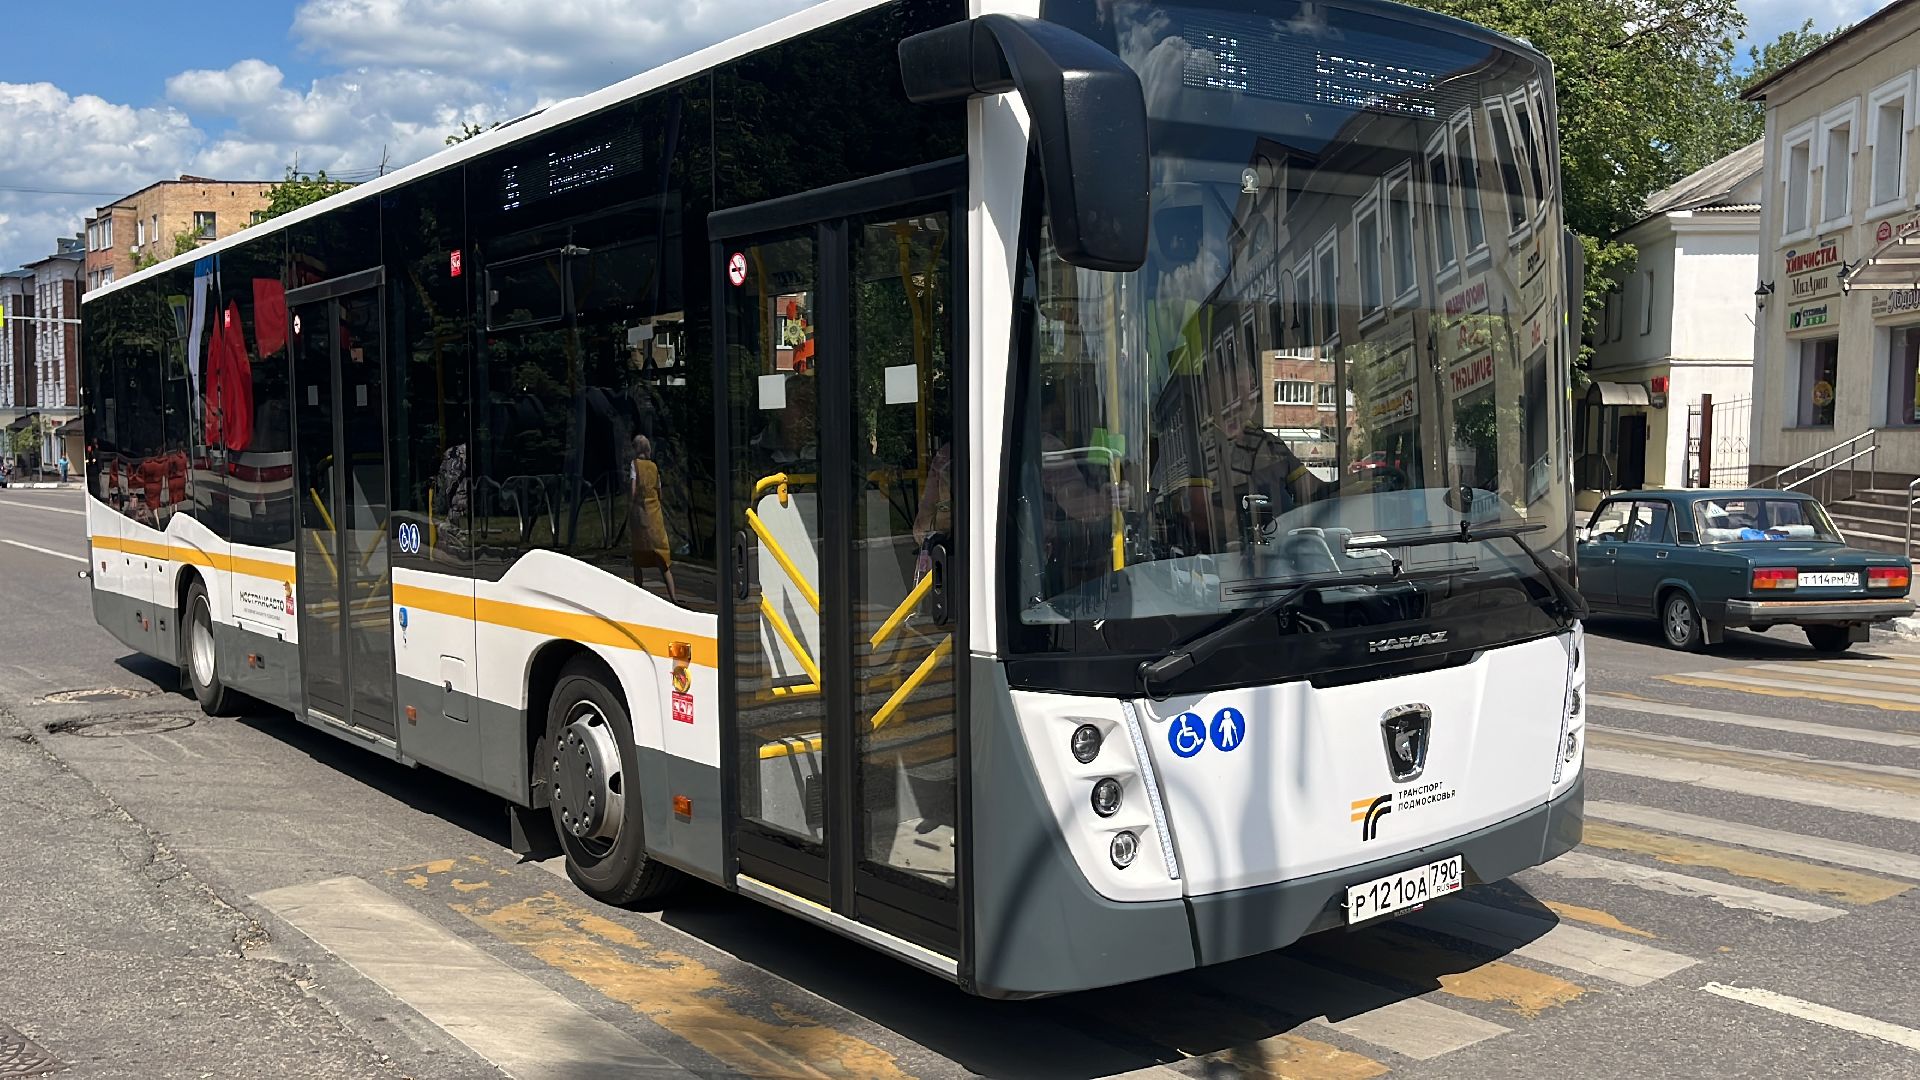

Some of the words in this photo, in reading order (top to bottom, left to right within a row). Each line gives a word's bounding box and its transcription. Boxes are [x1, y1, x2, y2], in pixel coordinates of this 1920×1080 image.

[1785, 246, 1837, 274] ХИМЧИСТКА
[1368, 630, 1448, 653] KAMAZ
[1398, 781, 1443, 799] ТРАНСПОРТ
[1398, 789, 1456, 811] ПОДМОСКОВЬЯ
[1431, 860, 1458, 886] 790
[1436, 883, 1450, 893] RUS
